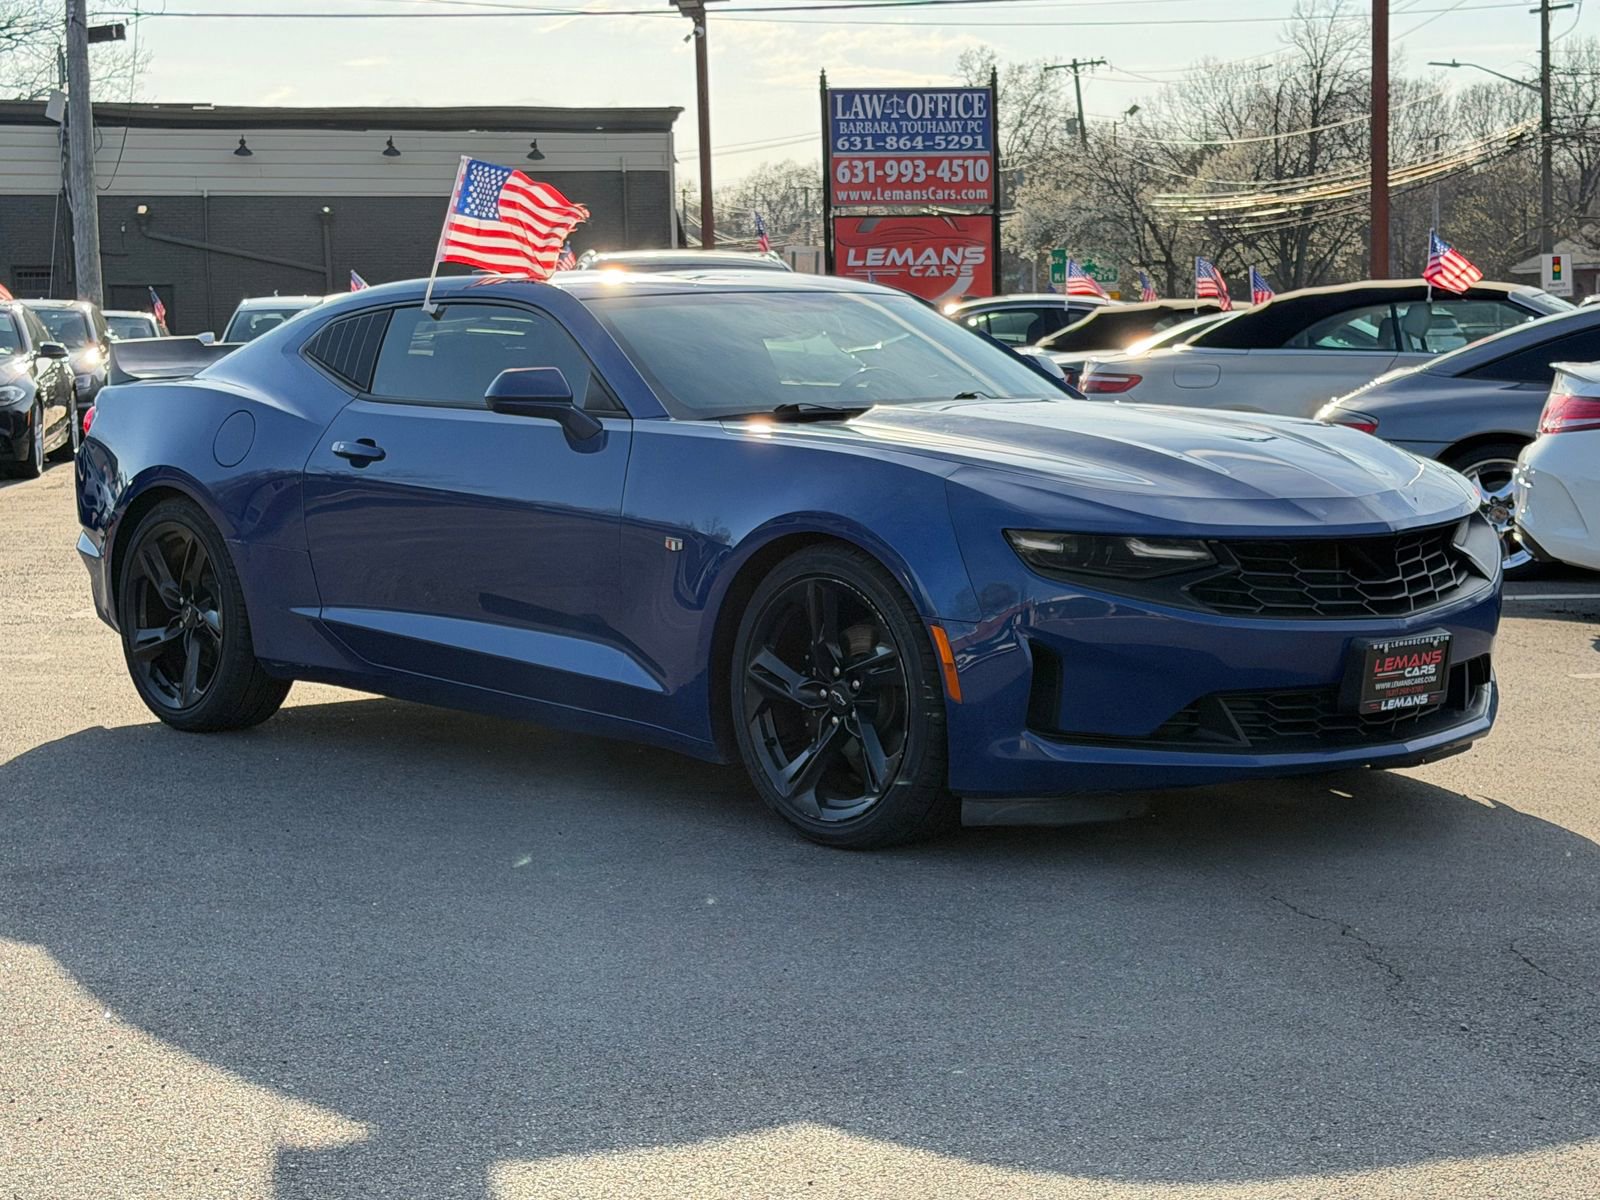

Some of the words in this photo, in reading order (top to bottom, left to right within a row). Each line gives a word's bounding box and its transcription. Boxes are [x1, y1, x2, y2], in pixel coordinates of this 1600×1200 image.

[835, 94, 884, 119] LAW
[906, 93, 987, 119] OFFICE
[840, 122, 898, 133] BARBARA
[900, 121, 963, 133] TOUHAMY
[966, 121, 983, 133] PC
[837, 135, 985, 150] 631-864-5291
[837, 160, 988, 183] 631-993-4510
[837, 187, 988, 201] www.LemansCars.com
[847, 247, 986, 267] LEMANS
[909, 265, 975, 277] CARS
[1374, 650, 1442, 673] LEMANS
[1404, 664, 1436, 677] CARS
[1375, 676, 1436, 690] WWW.LEMANSCARS.COM
[1381, 694, 1428, 711] LEMANS
